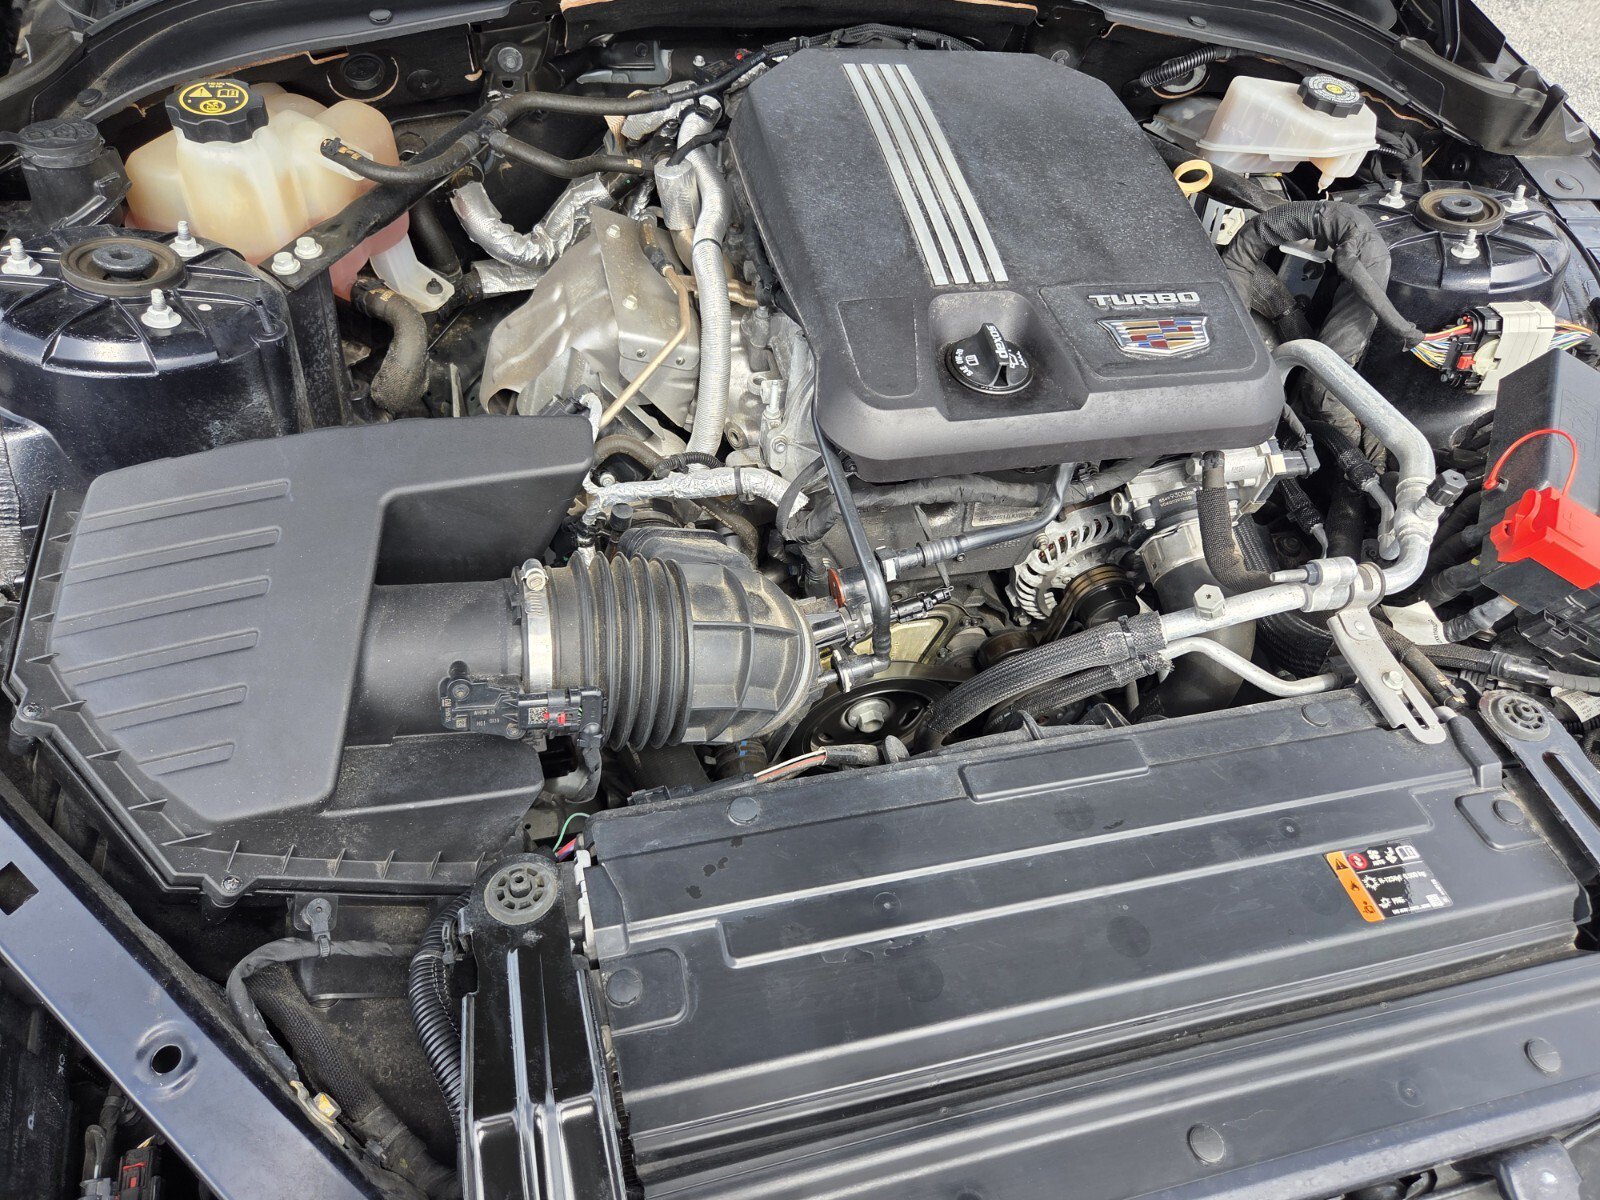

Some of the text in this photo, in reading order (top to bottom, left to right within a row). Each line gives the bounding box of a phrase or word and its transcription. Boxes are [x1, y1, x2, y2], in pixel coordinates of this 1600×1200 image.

[1087, 291, 1201, 307] TURBO
[985, 324, 1010, 359] dexos
[959, 365, 974, 377] SAE
